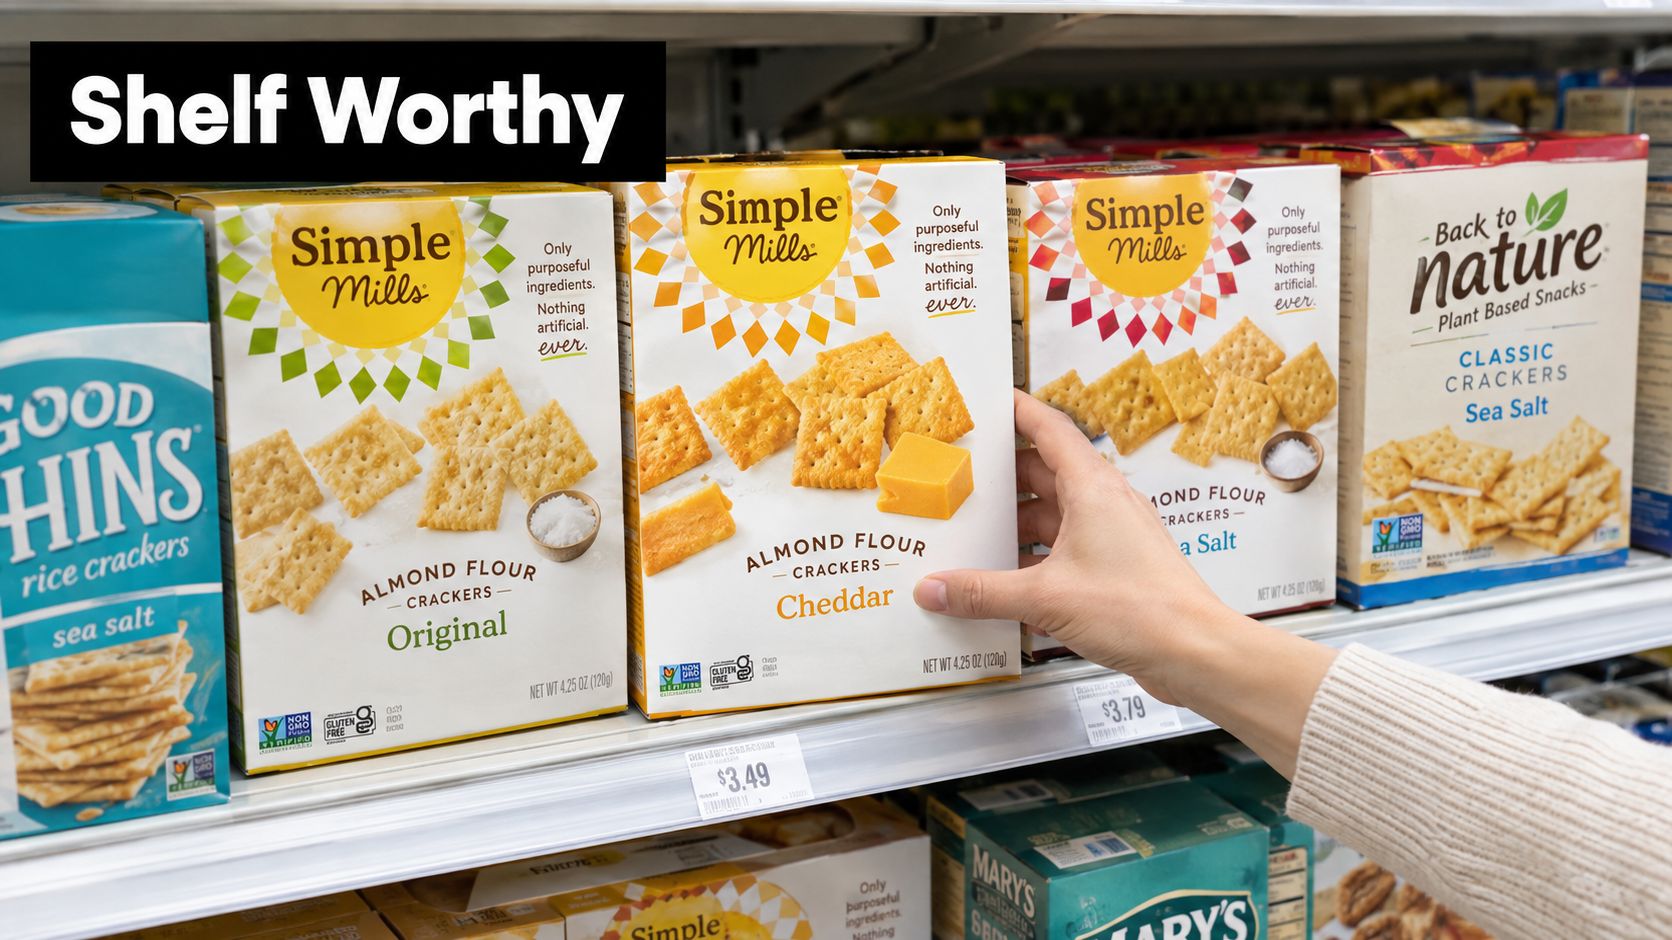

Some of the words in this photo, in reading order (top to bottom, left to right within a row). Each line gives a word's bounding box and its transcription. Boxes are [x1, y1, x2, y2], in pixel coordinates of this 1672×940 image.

[699, 187, 838, 231] Simple
[933, 204, 961, 219] Only
[1086, 194, 1205, 235] Simple
[1281, 205, 1305, 220] Only
[916, 220, 979, 237] purposeful
[1268, 221, 1320, 238] purposeful
[1436, 213, 1489, 247] Back
[1496, 206, 1517, 229] to
[291, 222, 451, 273] Simple
[544, 242, 572, 256] Only
[724, 233, 818, 265] Mills
[914, 239, 984, 255] ingredients.
[1107, 236, 1188, 264] Mills
[1266, 240, 1324, 256] ingredients.
[528, 258, 590, 277] purposeful
[925, 261, 973, 275] Nothing
[1275, 261, 1315, 275] Nothing
[1410, 220, 1603, 314] nature
[321, 273, 429, 309] Mills
[526, 279, 595, 295] ingredients.
[925, 277, 977, 292] artificial.
[1274, 276, 1318, 291] artificial.
[537, 301, 585, 315] Nothing
[925, 296, 976, 313] ever.
[1274, 295, 1316, 311] ever.
[1437, 305, 1479, 333] Plant
[1484, 295, 1530, 324] Based
[1535, 280, 1586, 311] Snacks
[537, 318, 589, 334] artificial.
[538, 338, 588, 355] ever.
[1459, 343, 1554, 369] CLASSIC
[1445, 364, 1568, 393] CRACKERS
[1465, 398, 1503, 424] Sea
[1509, 396, 1549, 420] Salt
[0, 427, 203, 564] HINS
[1151, 487, 1200, 508] OND
[1209, 486, 1266, 506] FLOUR
[746, 534, 844, 573] ALMOND
[855, 532, 926, 557] FLOUR
[1198, 530, 1237, 554] Salt
[21, 564, 78, 598] rice
[84, 532, 189, 581] crackers
[793, 558, 880, 579] CRACKERS
[360, 563, 456, 606] ALMOND
[466, 560, 537, 581] FLOUR
[407, 586, 492, 609] CRACKERS
[776, 585, 894, 620] Cheddar
[53, 622, 97, 648] sea
[105, 606, 155, 636] salt
[387, 609, 508, 651] Original
[923, 658, 938, 673] NET
[939, 657, 951, 671] WT
[953, 655, 970, 670] 4.25
[972, 653, 982, 669] OZ
[530, 683, 544, 700] NET
[546, 681, 558, 697] WT
[560, 677, 577, 694] 4.25
[578, 675, 588, 690] OZ
[590, 671, 613, 690] (120g)
[288, 713, 310, 723] NON
[1102, 695, 1146, 722] $3.79
[326, 717, 355, 730] GLUTEN
[326, 728, 345, 738] FREE
[717, 761, 771, 793] $3.49
[860, 879, 886, 894] Only
[973, 844, 1035, 918] MARY'S
[631, 914, 720, 940] Simple
